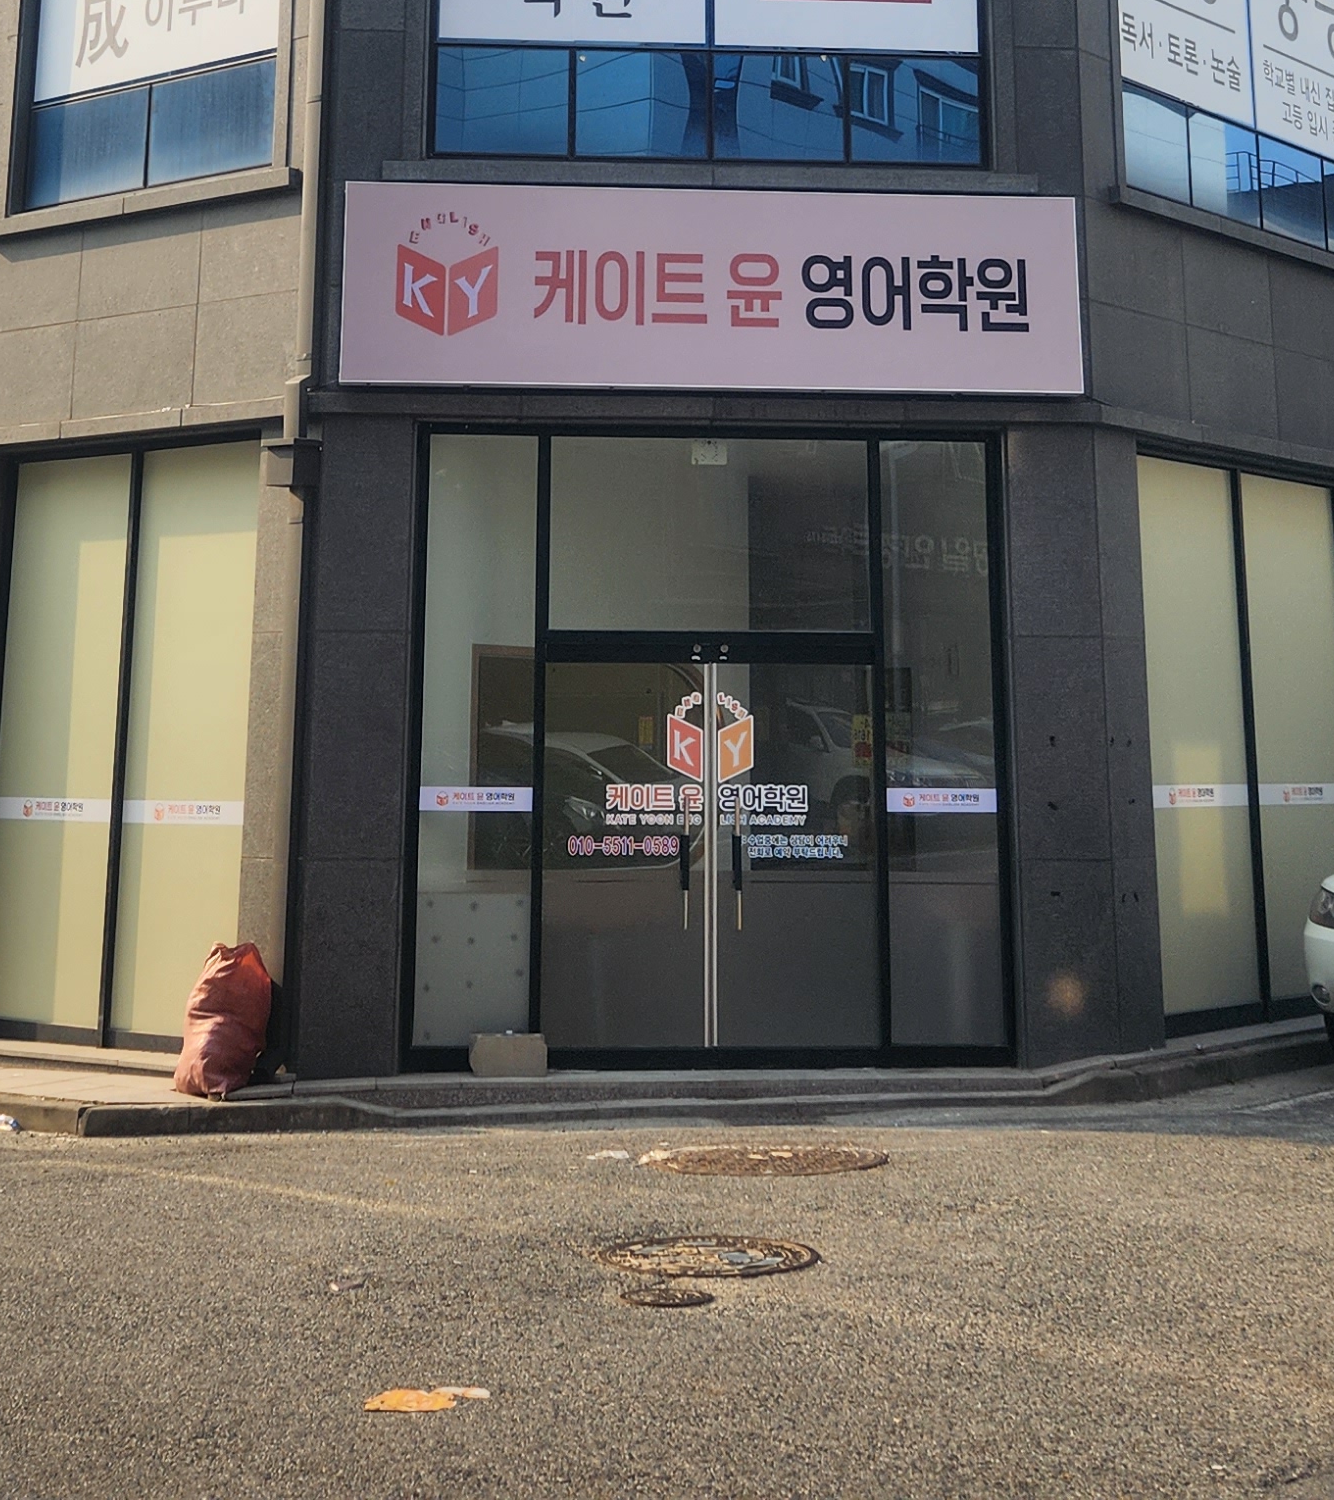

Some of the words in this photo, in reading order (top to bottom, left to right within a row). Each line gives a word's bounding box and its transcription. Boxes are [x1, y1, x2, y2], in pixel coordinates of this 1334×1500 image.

[1263, 59, 1296, 96] 학교별
[1300, 77, 1321, 107] 내신
[1282, 101, 1303, 131] 고등
[1307, 110, 1329, 141] 입시
[409, 212, 490, 247] ENGLISH
[534, 249, 708, 326] 케이트
[727, 252, 784, 329] 윤
[801, 254, 1030, 334] 영어학원
[606, 784, 675, 811] 케이트
[718, 784, 808, 812] 영어학원
[606, 814, 637, 825] KATE
[639, 814, 674, 825] YOON
[677, 814, 702, 825] EG
[749, 814, 806, 825] ACADEMY
[568, 835, 679, 856] 010-5511-0589
